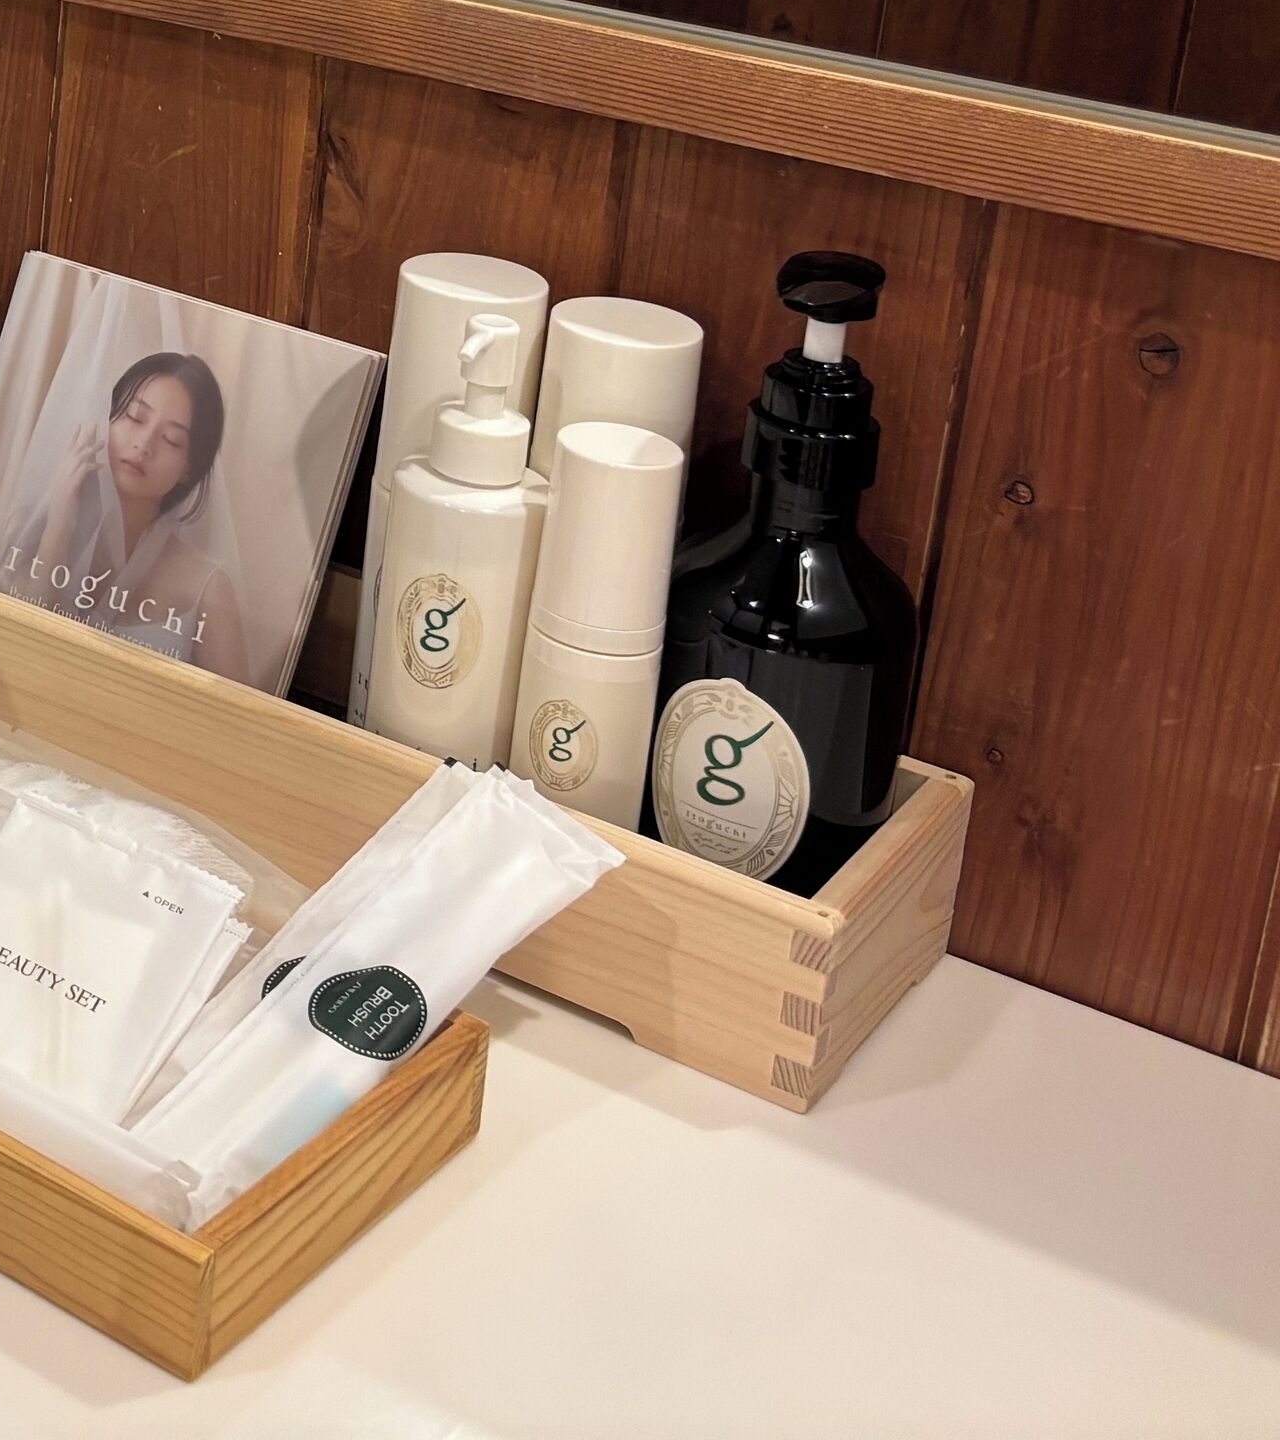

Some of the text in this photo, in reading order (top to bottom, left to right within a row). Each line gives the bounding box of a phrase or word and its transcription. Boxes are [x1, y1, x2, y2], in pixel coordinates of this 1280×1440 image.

[4, 546, 207, 644] Itoguchi
[696, 720, 774, 806] g
[153, 895, 185, 915] OPEN
[64, 984, 107, 1013] SET
[347, 985, 393, 1027] BRUSH
[364, 999, 411, 1040] TOOTH
